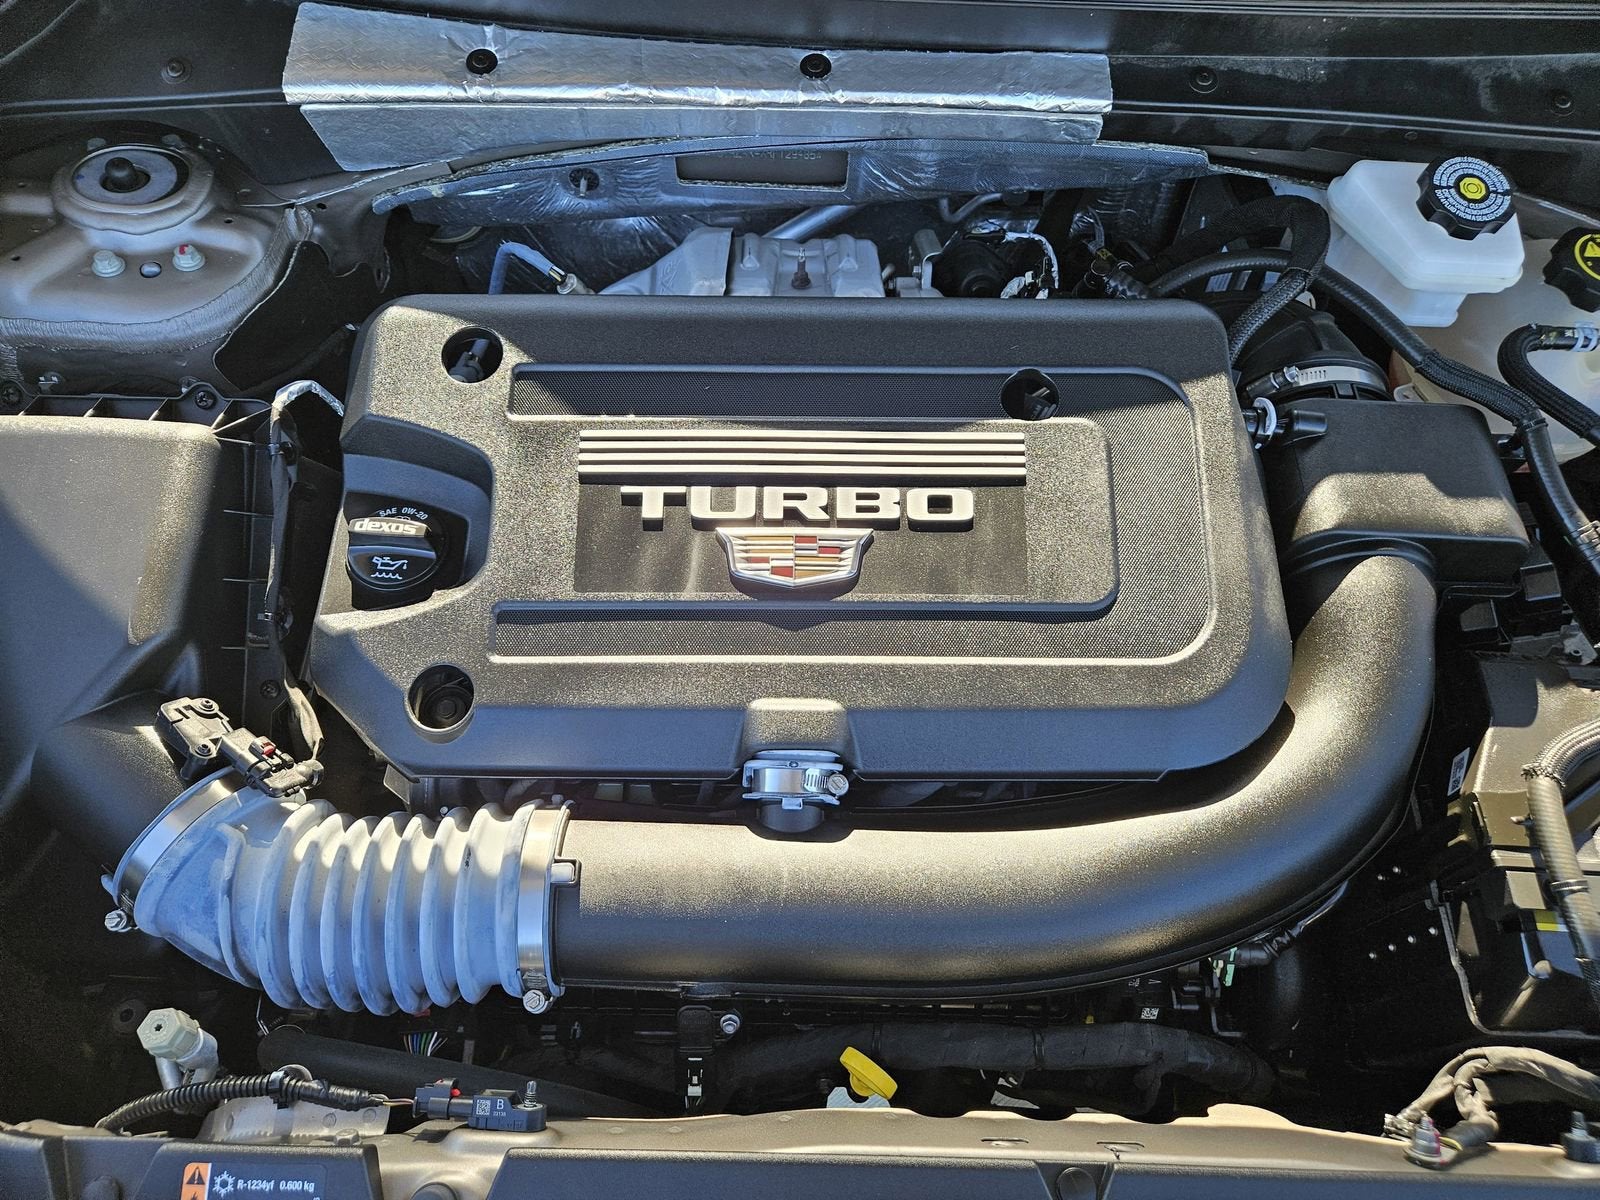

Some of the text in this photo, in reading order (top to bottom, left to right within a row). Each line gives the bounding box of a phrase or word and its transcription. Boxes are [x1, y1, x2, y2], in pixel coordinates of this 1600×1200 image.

[1435, 189, 1445, 199] DOT
[1442, 200, 1457, 213] FLUID
[1456, 209, 1471, 220] FROM
[620, 485, 974, 524] TURBO
[379, 507, 429, 520] SAE 0W-20
[354, 518, 417, 535] dexos
[496, 1099, 504, 1110] B
[237, 1179, 315, 1193] R-1234yf 0.600 kg
